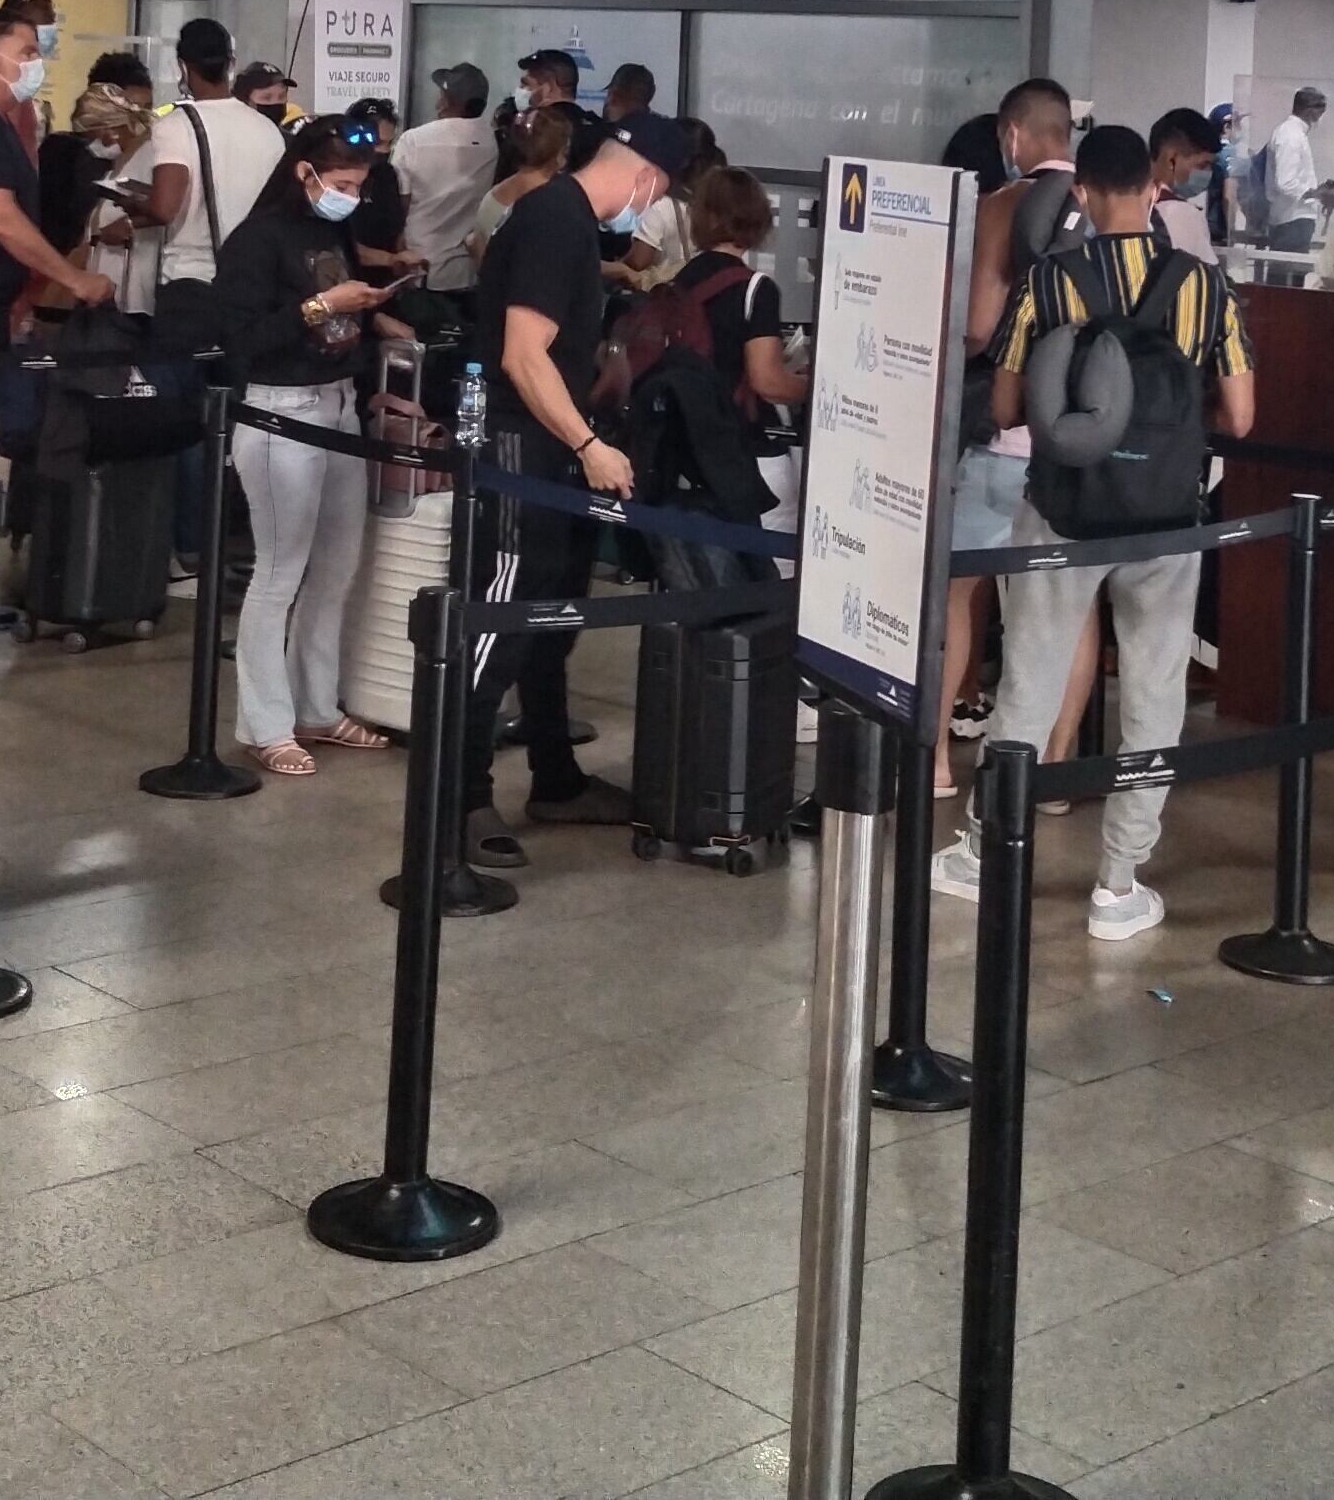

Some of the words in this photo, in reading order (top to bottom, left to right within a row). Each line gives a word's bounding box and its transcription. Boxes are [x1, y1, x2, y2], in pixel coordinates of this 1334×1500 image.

[326, 9, 394, 37] PURA
[328, 71, 353, 82] VIAJE
[355, 71, 391, 83] SEGURO
[326, 86, 358, 97] TRAVEL
[871, 190, 931, 215] PREFERENCIAL
[832, 526, 866, 555] Tripulación
[867, 601, 909, 637] Diplomáticos
